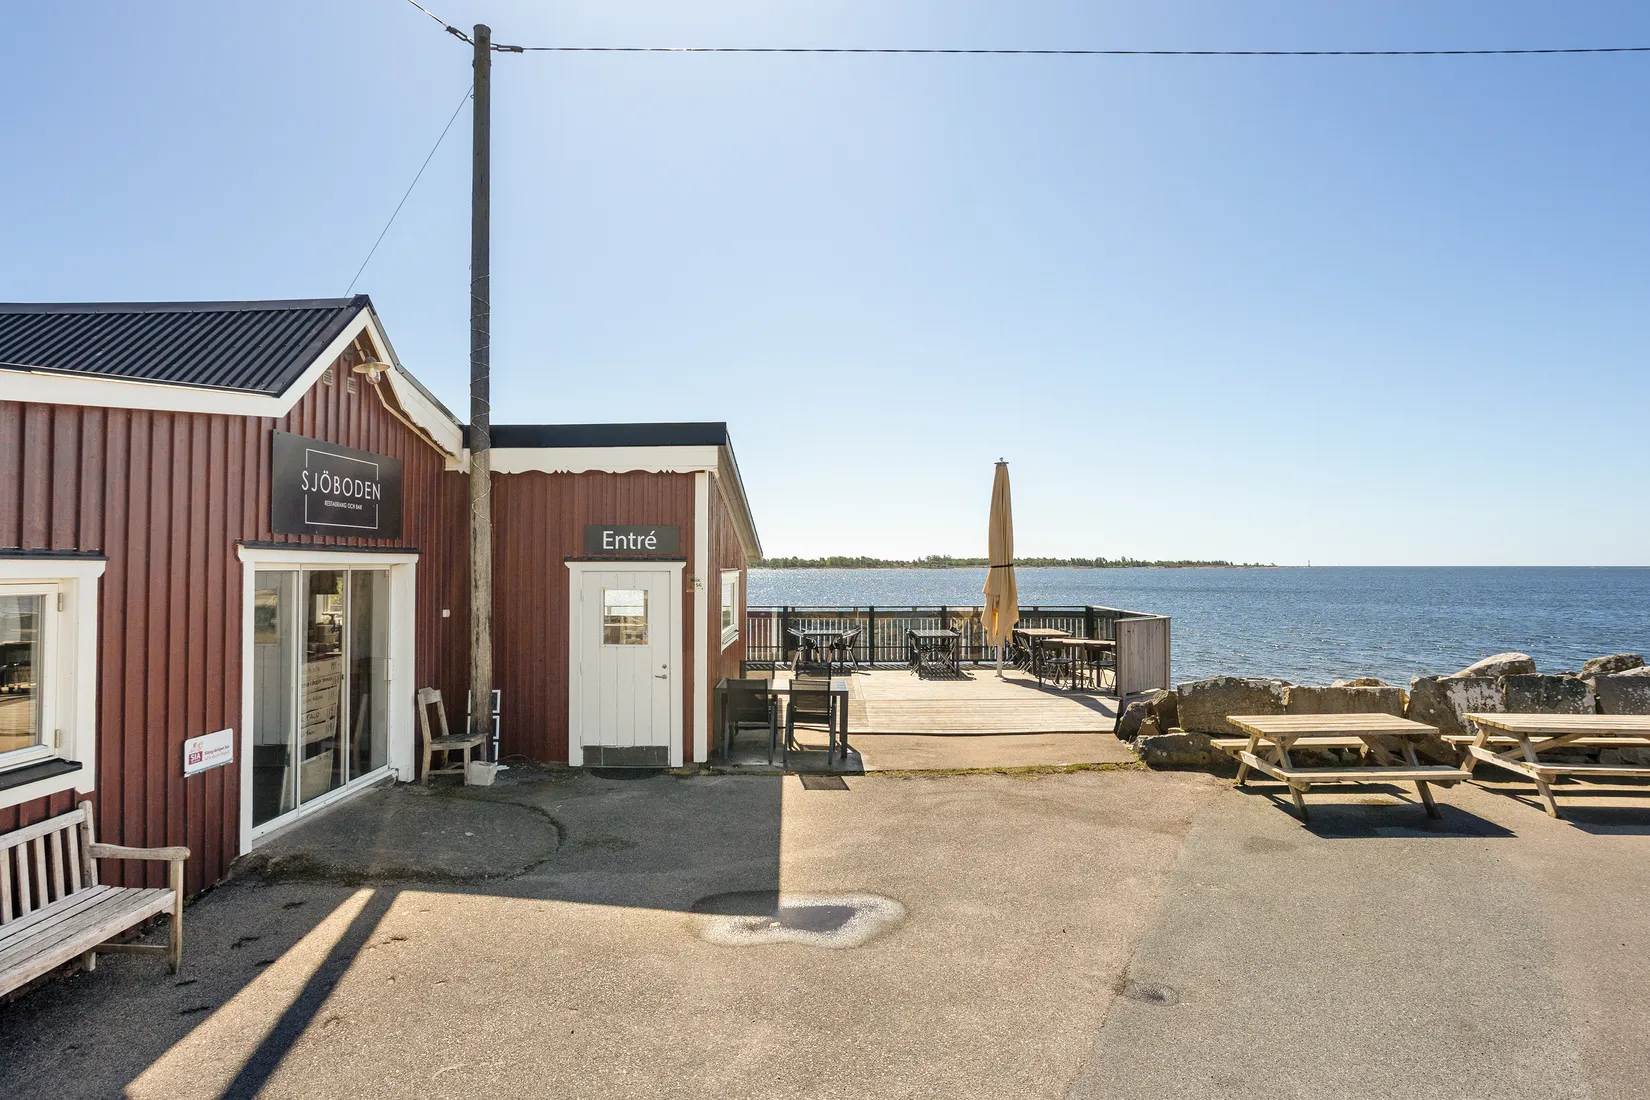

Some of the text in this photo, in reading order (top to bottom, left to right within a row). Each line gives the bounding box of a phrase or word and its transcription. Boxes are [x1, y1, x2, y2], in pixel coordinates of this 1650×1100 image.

[302, 470, 380, 500] SJÖBODEN
[324, 500, 347, 508] RESTAURANG
[603, 531, 657, 549] Entré
[190, 752, 201, 761] SIA
